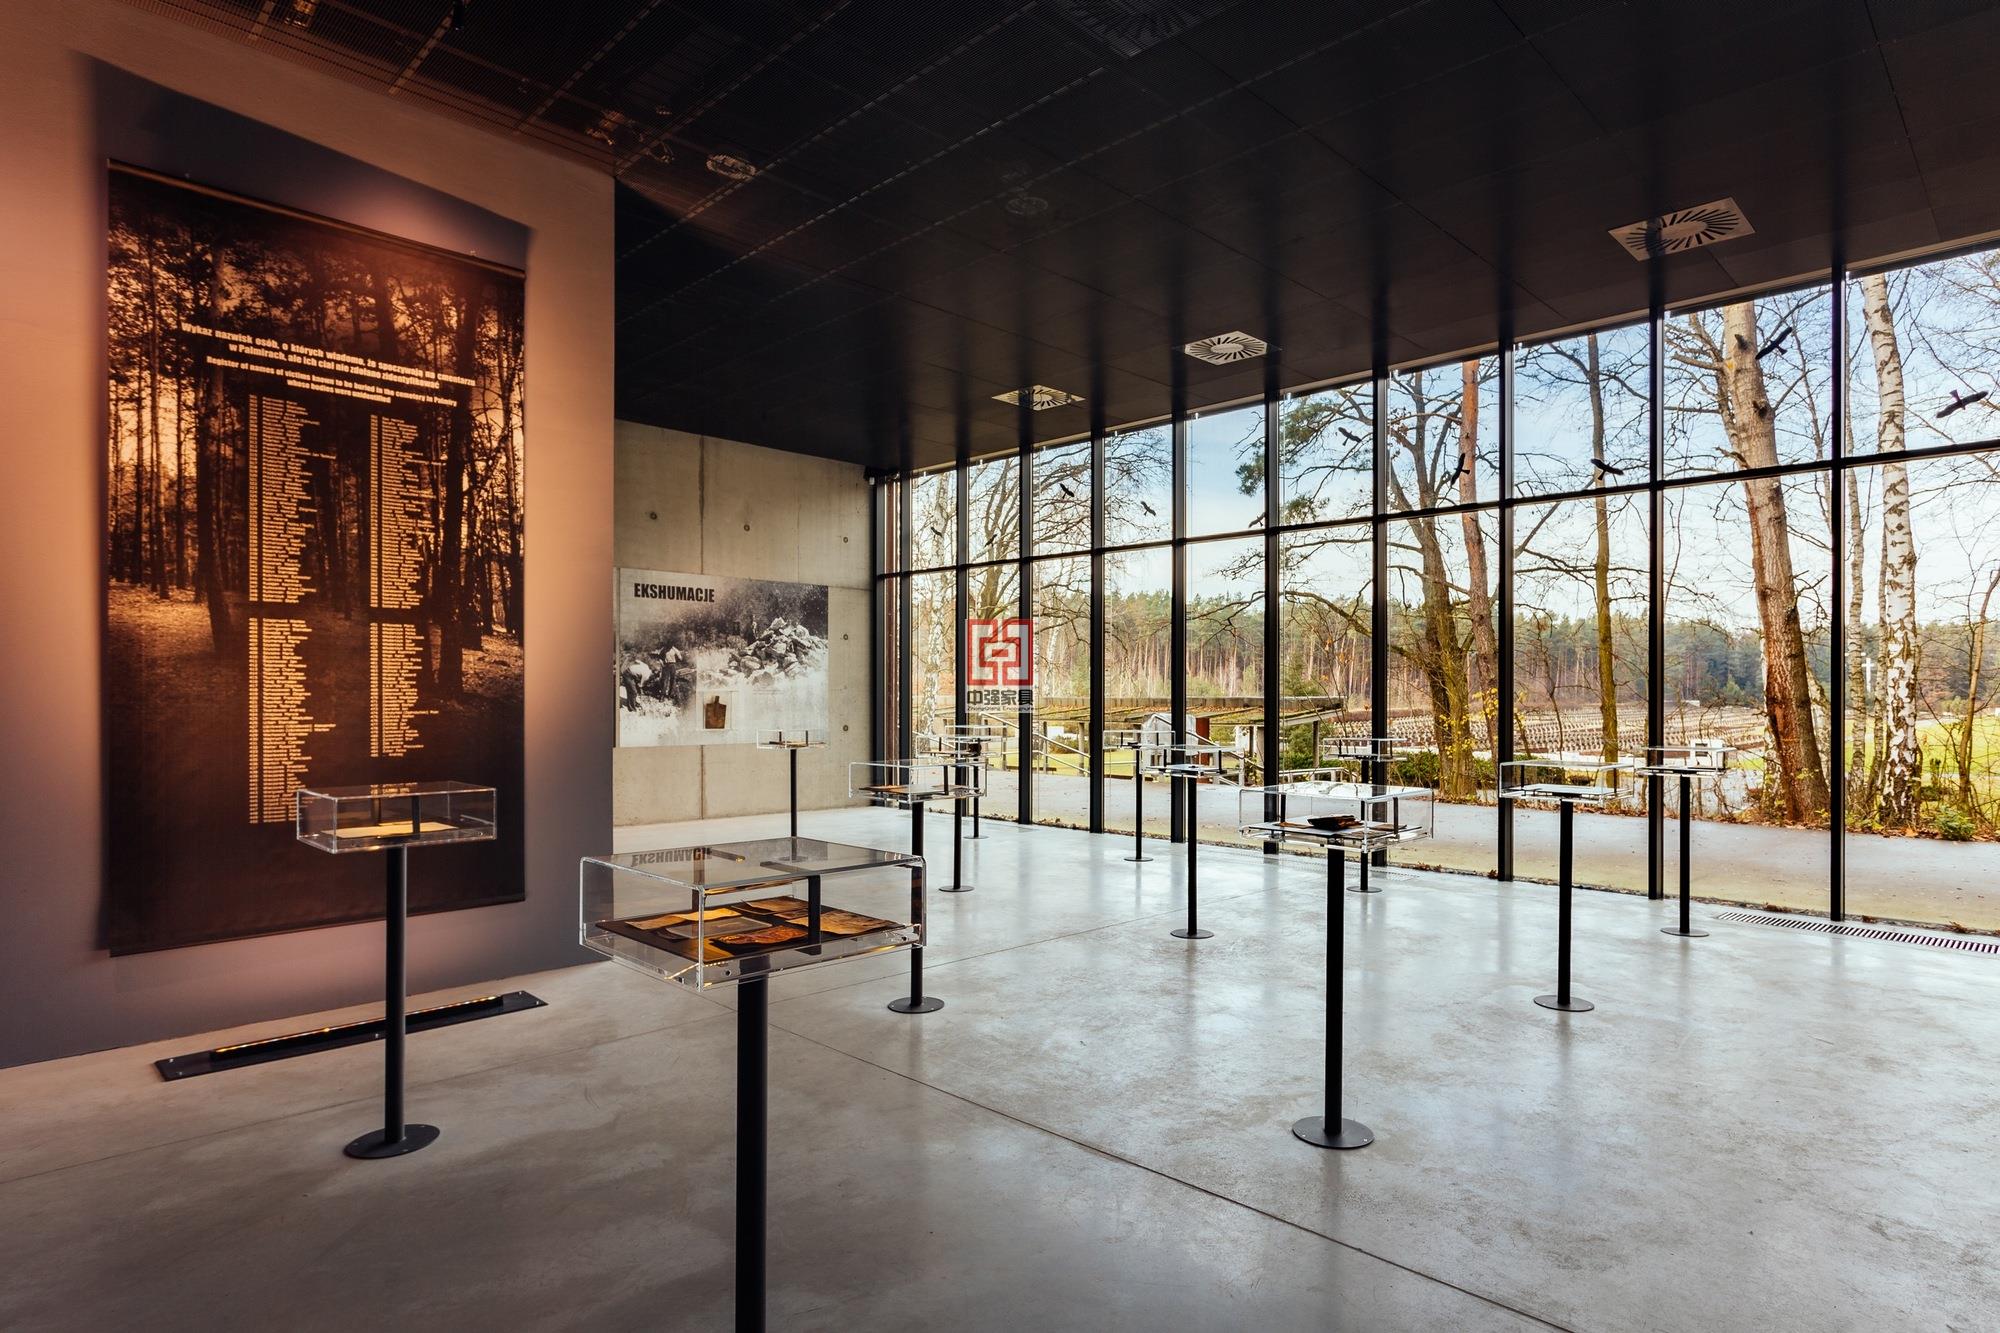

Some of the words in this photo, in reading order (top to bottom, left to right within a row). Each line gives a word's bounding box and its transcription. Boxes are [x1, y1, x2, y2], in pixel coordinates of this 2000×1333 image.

[181, 322, 212, 337] Wykaz
[215, 330, 252, 344] nazwisk
[290, 344, 324, 358] których
[634, 583, 715, 603] EKSHUMACJE
